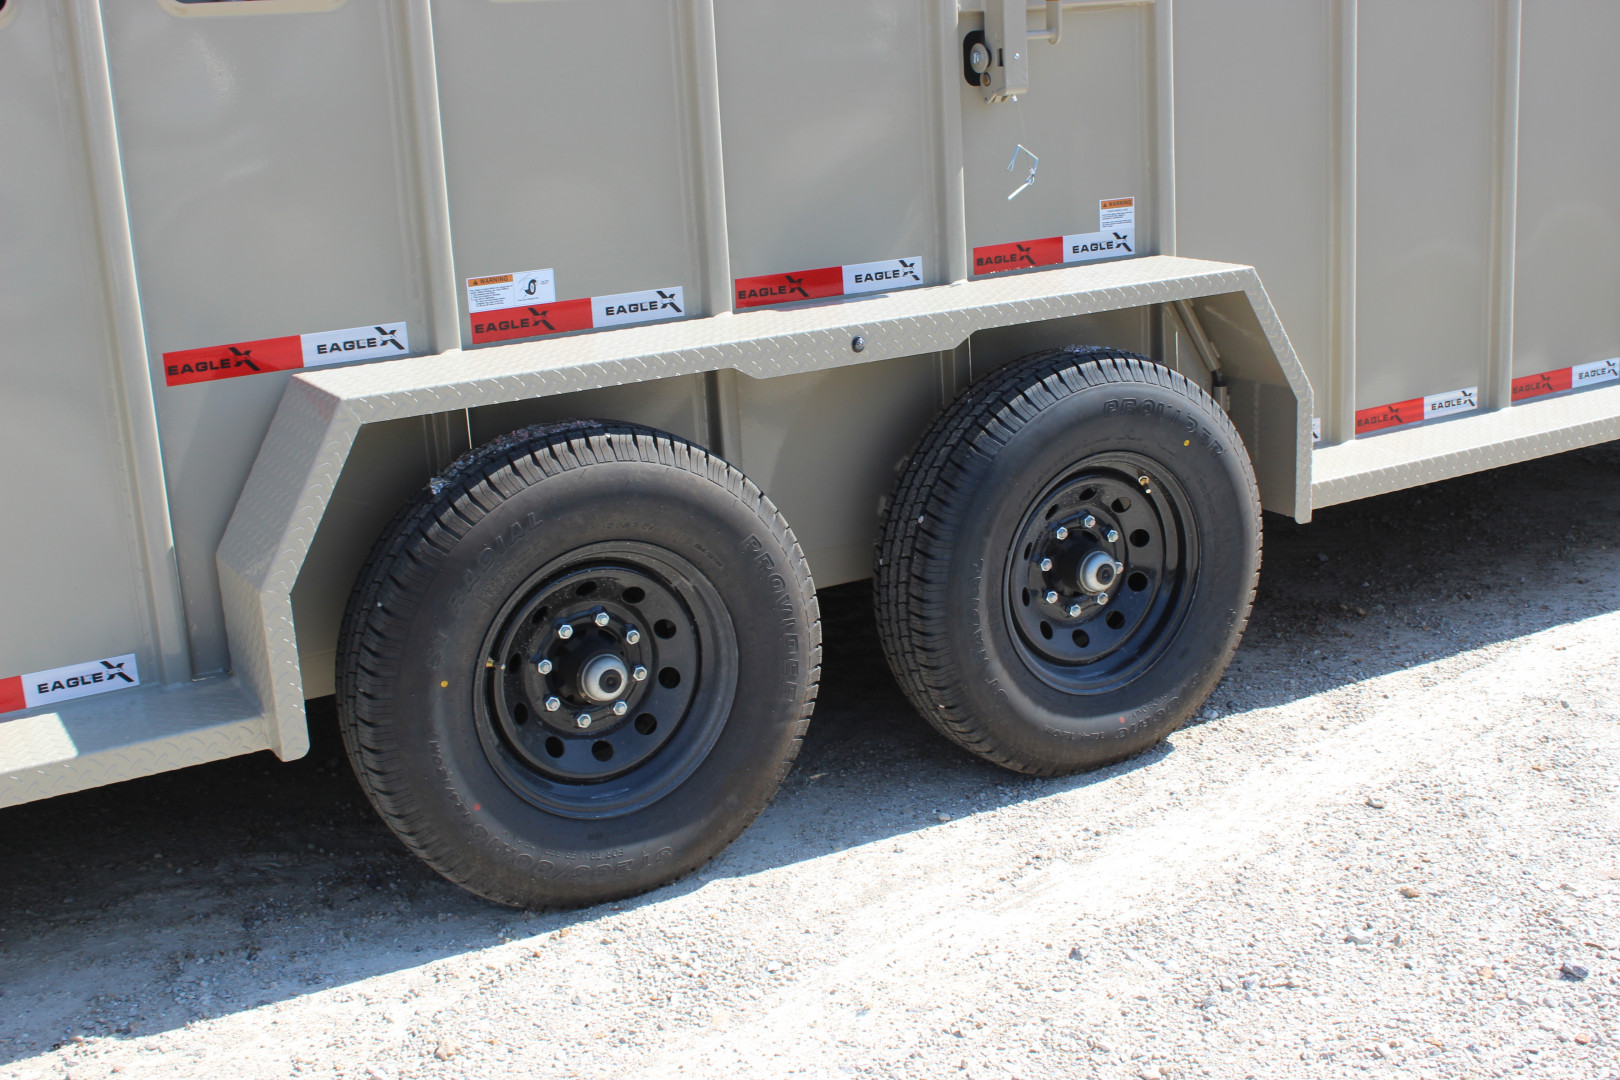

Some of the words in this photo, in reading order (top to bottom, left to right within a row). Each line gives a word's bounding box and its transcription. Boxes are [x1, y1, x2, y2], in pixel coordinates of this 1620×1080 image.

[976, 244, 1035, 266] EAGLEX
[1072, 232, 1132, 254] EAGLEX
[480, 275, 508, 284] WARNING
[854, 259, 920, 284] EAGLEX
[738, 275, 809, 300] EAGLEX
[605, 290, 682, 316] EAGLEX
[475, 307, 555, 334] EAGLEX
[316, 326, 405, 354] EAGLEX
[167, 347, 260, 376] EAGLEX
[1104, 398, 1223, 460] PROVIDER
[741, 533, 800, 702] PROVIDER
[37, 660, 134, 694] EAGLEX
